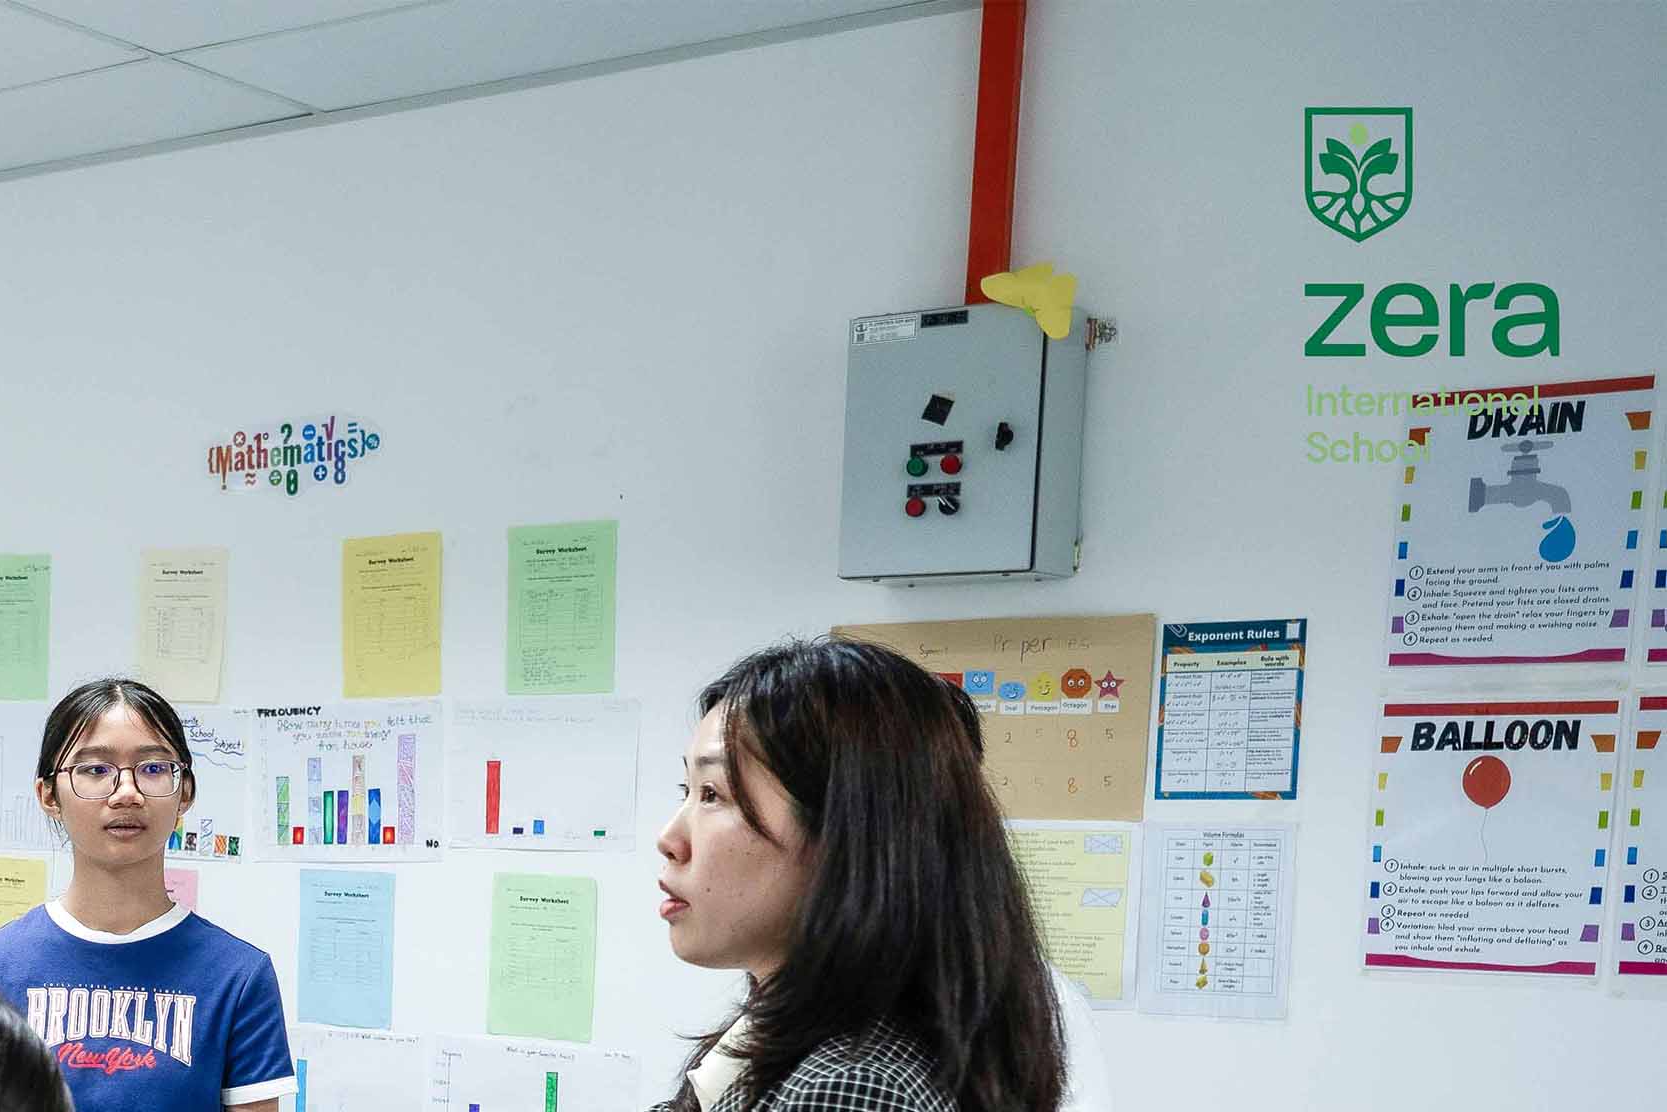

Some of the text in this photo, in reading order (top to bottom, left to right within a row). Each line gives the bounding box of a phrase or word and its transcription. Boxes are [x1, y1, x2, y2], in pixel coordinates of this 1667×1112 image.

[1467, 401, 1585, 440] DRAIN
[1188, 628, 1280, 643] Exponent Rules
[257, 706, 321, 718] FREQUENCY
[1062, 701, 1087, 710] Octagon
[190, 728, 214, 737] School
[1004, 732, 1012, 744] 2
[1067, 729, 1078, 748] 8
[1105, 728, 1114, 741] 5
[1411, 720, 1581, 751] BALLOON
[1104, 776, 1112, 786] 5
[27, 987, 196, 1067] BROOKLYN
[57, 1043, 156, 1076] New York
